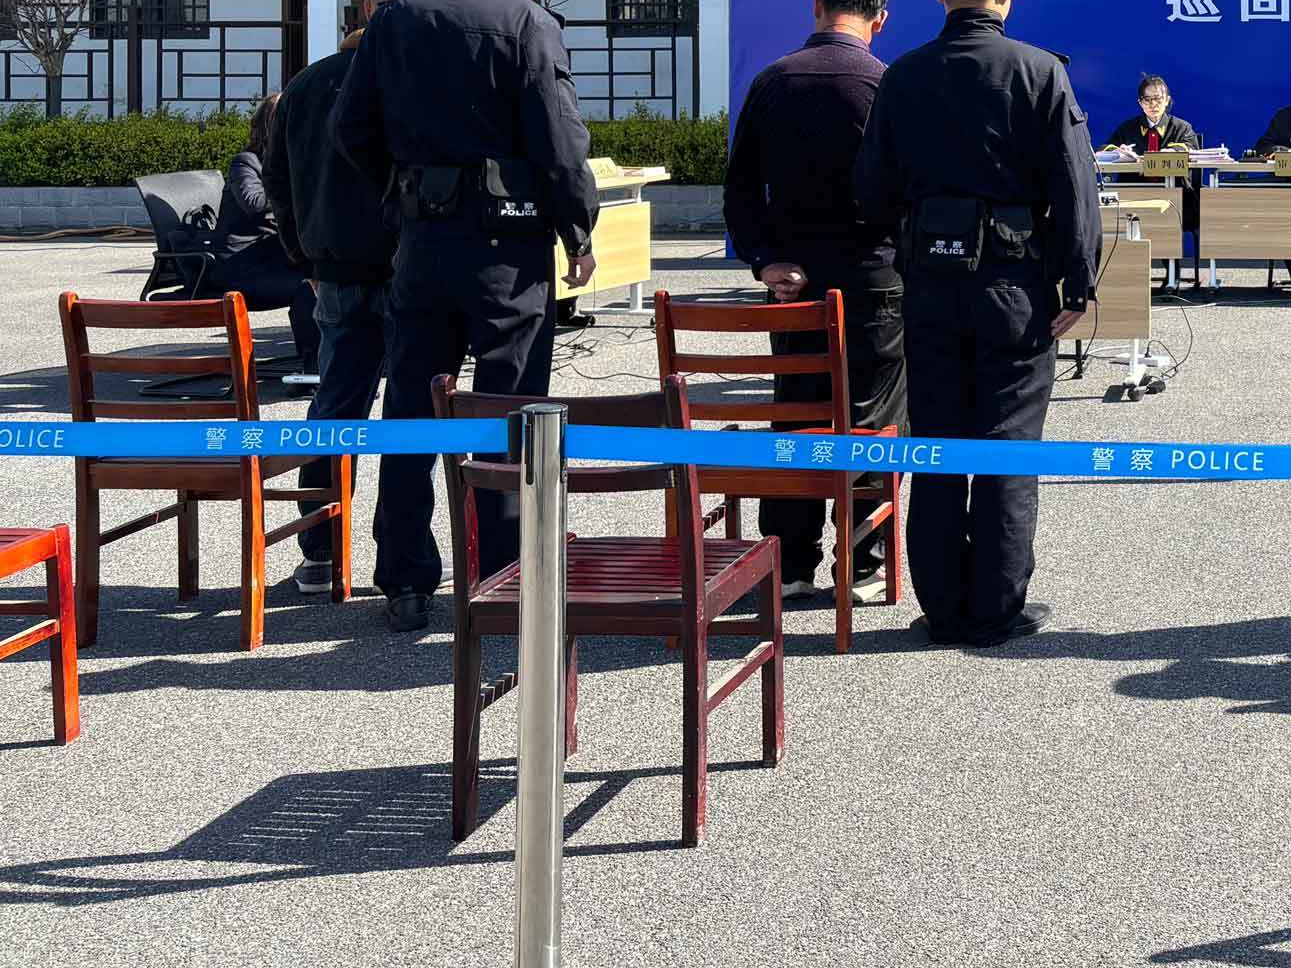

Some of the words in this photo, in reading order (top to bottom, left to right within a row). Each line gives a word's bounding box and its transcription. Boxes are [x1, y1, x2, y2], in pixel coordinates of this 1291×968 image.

[500, 209, 538, 217] POLICE
[930, 247, 965, 255] POLICE
[205, 428, 264, 450] 警察
[280, 427, 368, 447] POLICE
[773, 439, 835, 463] 警察
[851, 443, 943, 465] POLICE
[1091, 448, 1154, 471] 警察
[1171, 450, 1264, 471] POLICE
